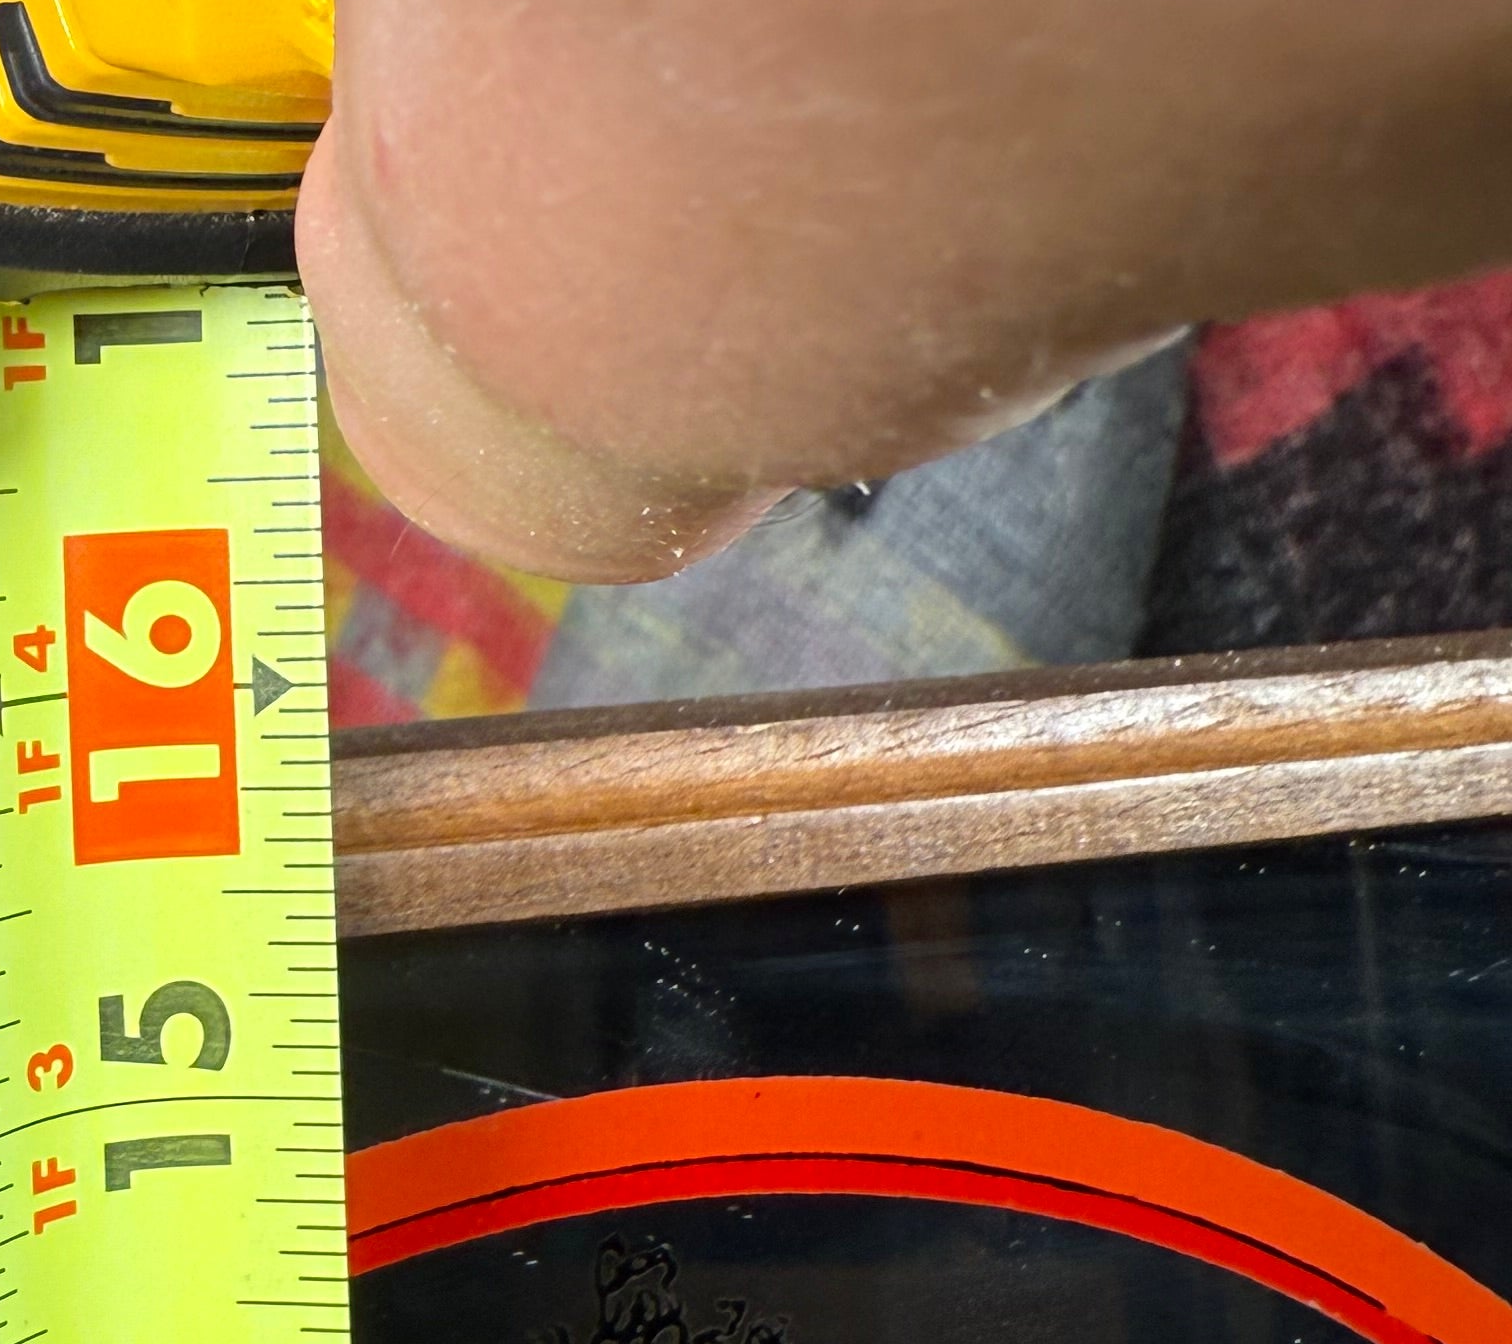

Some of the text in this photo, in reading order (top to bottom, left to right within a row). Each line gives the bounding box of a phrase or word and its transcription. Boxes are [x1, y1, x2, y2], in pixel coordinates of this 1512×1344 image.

[2, 316, 48, 391] 1F
[74, 309, 203, 365] 1
[13, 624, 63, 814] 1F 4
[84, 579, 222, 803] 16
[27, 1043, 78, 1236] 1F 3
[97, 979, 232, 1192] 15
